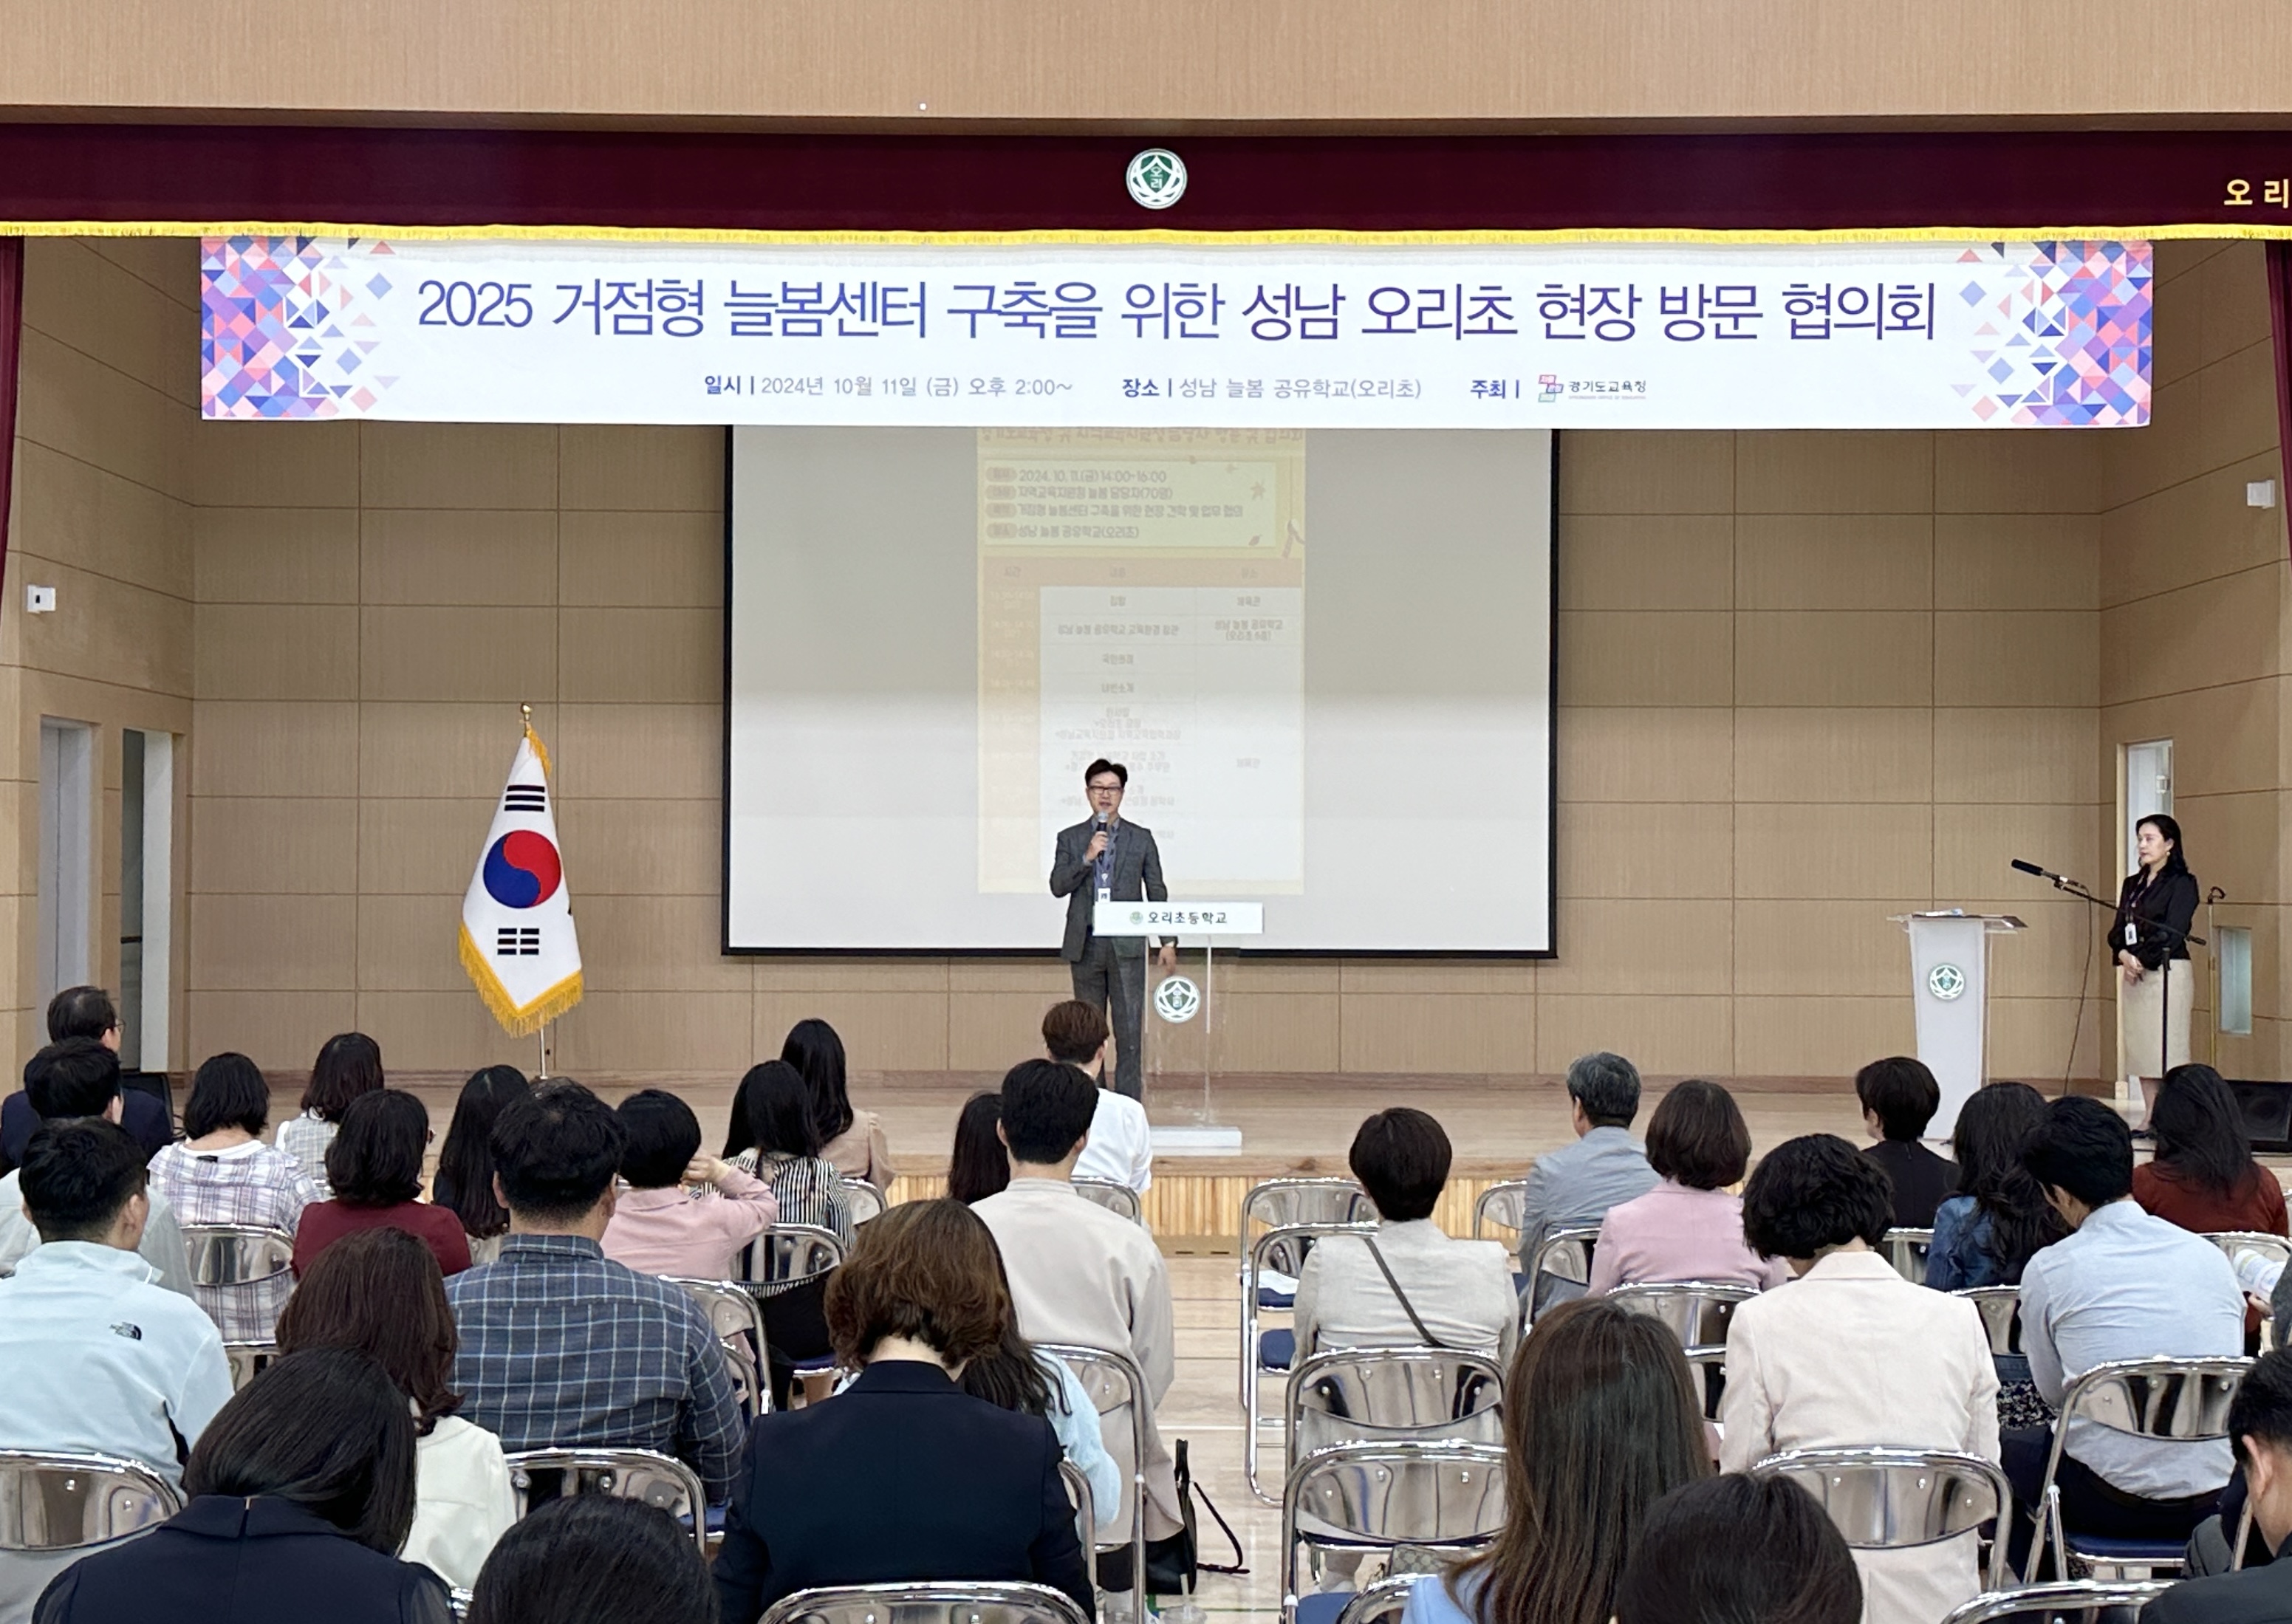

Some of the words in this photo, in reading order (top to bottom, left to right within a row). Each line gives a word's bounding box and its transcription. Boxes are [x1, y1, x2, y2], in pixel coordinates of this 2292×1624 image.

[2223, 178, 2289, 209] 오리
[418, 279, 533, 329] 2025
[552, 278, 704, 338] 거점형
[723, 279, 926, 339] 늘봄센터
[946, 281, 1104, 340] 구축을
[1121, 282, 1226, 340] 위한
[1241, 283, 1347, 341] 성남
[1361, 283, 1519, 341] 오리초
[1536, 283, 1643, 342] 현장
[1660, 283, 1764, 343] 방문
[1782, 282, 1934, 340] 협의회
[705, 375, 742, 396] 일시
[761, 376, 824, 397] 2024년
[834, 375, 872, 397] 10월
[881, 376, 917, 397] 11일
[926, 376, 959, 398] (금)
[968, 377, 1007, 397] 오후
[1015, 377, 1073, 396] 2:00~
[1121, 377, 1161, 399] 장소
[1179, 377, 1218, 399] 성남
[1225, 377, 1265, 399] 늘봄
[1273, 377, 1423, 400] 공유학교(오리초)
[1469, 378, 1507, 400] 주최
[1568, 380, 1647, 394] 경기도교육청
[1147, 911, 1228, 925] 오리초등학교
